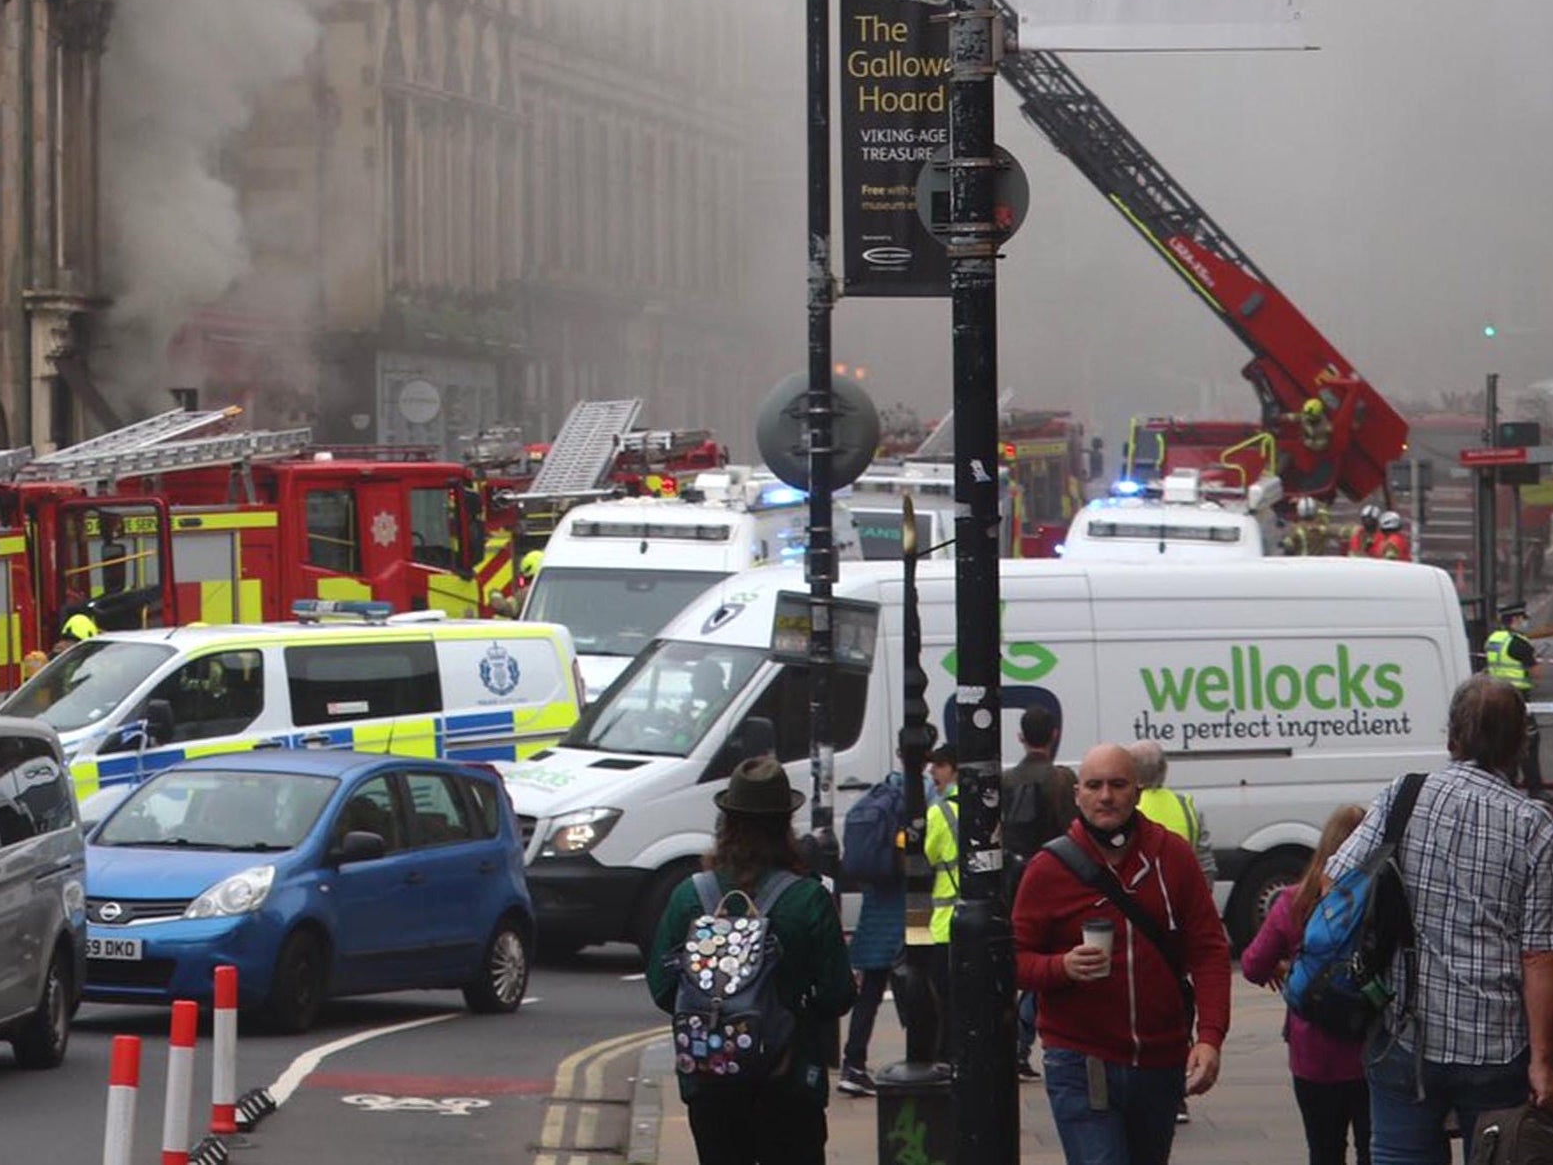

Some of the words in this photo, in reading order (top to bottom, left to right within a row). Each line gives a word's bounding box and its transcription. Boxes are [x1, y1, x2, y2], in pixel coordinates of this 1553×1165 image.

[854, 15, 908, 42] The
[858, 86, 944, 113] Hoard
[861, 129, 947, 143] VIKING-AGE
[862, 185, 885, 195] Free
[1139, 643, 1405, 713] wellocks
[1133, 710, 1174, 740] the
[1182, 709, 1273, 749] perfect
[1277, 710, 1411, 747] ingredient
